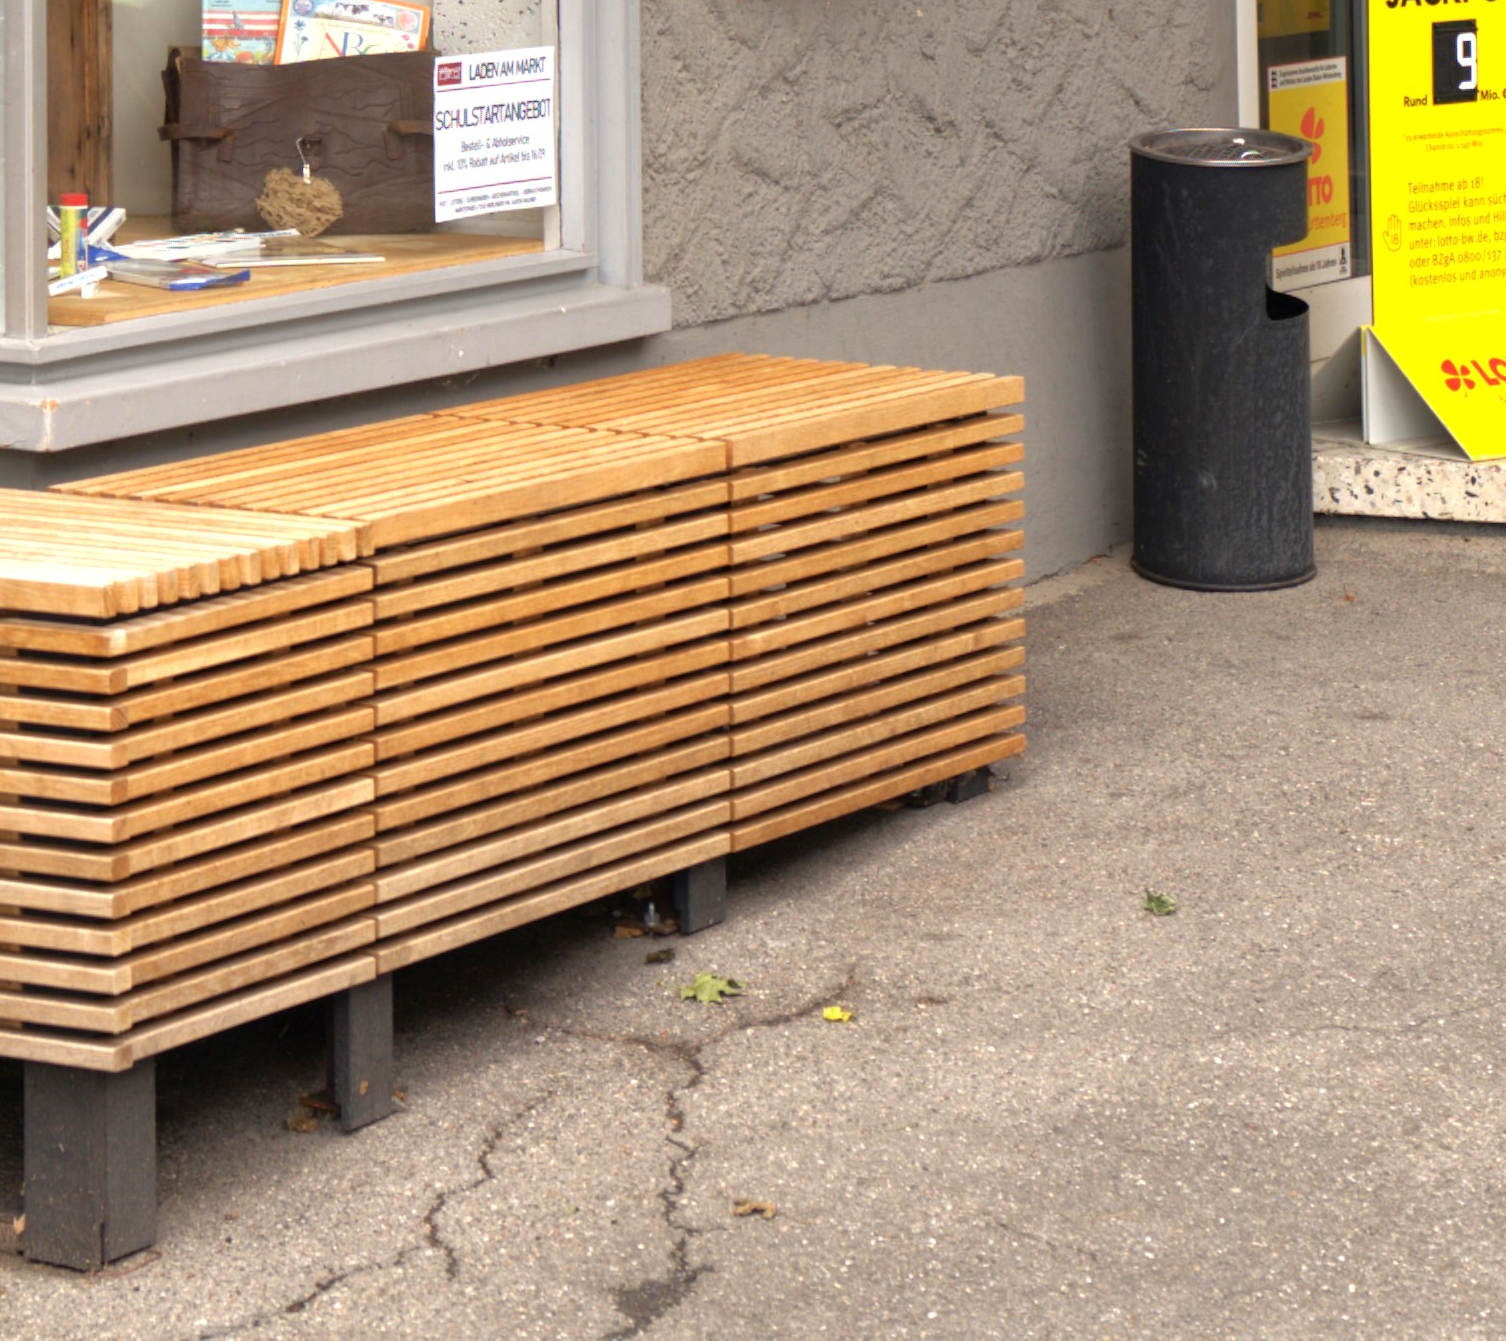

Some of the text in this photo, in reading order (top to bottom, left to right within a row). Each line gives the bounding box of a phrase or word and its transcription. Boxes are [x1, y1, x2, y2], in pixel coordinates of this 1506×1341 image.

[469, 62, 499, 81] LADEN
[499, 60, 514, 78] AM
[515, 56, 546, 76] MARKT
[1457, 32, 1478, 90] 9
[1403, 95, 1428, 108] Rund
[1480, 89, 1500, 101] Mio.
[435, 98, 551, 131] SCHULSTARTANGEBOT
[491, 135, 530, 148] Abholservice
[1308, 174, 1333, 207] TTO
[1408, 176, 1484, 195] Teilnahme ab 18!
[1408, 195, 1461, 213] Glücksspiel
[1463, 195, 1485, 208] kann
[1408, 218, 1447, 232] machen.
[1449, 215, 1471, 227] Infos
[1473, 213, 1491, 225] und
[1409, 238, 1437, 251] unter:
[1437, 230, 1492, 247] lotto-bw.de,
[1409, 255, 1430, 269] oder
[1432, 252, 1455, 267] BZgA
[1457, 249, 1501, 264] 0800/137
[1409, 271, 1457, 289] (kostenlos
[1459, 269, 1477, 282] und
